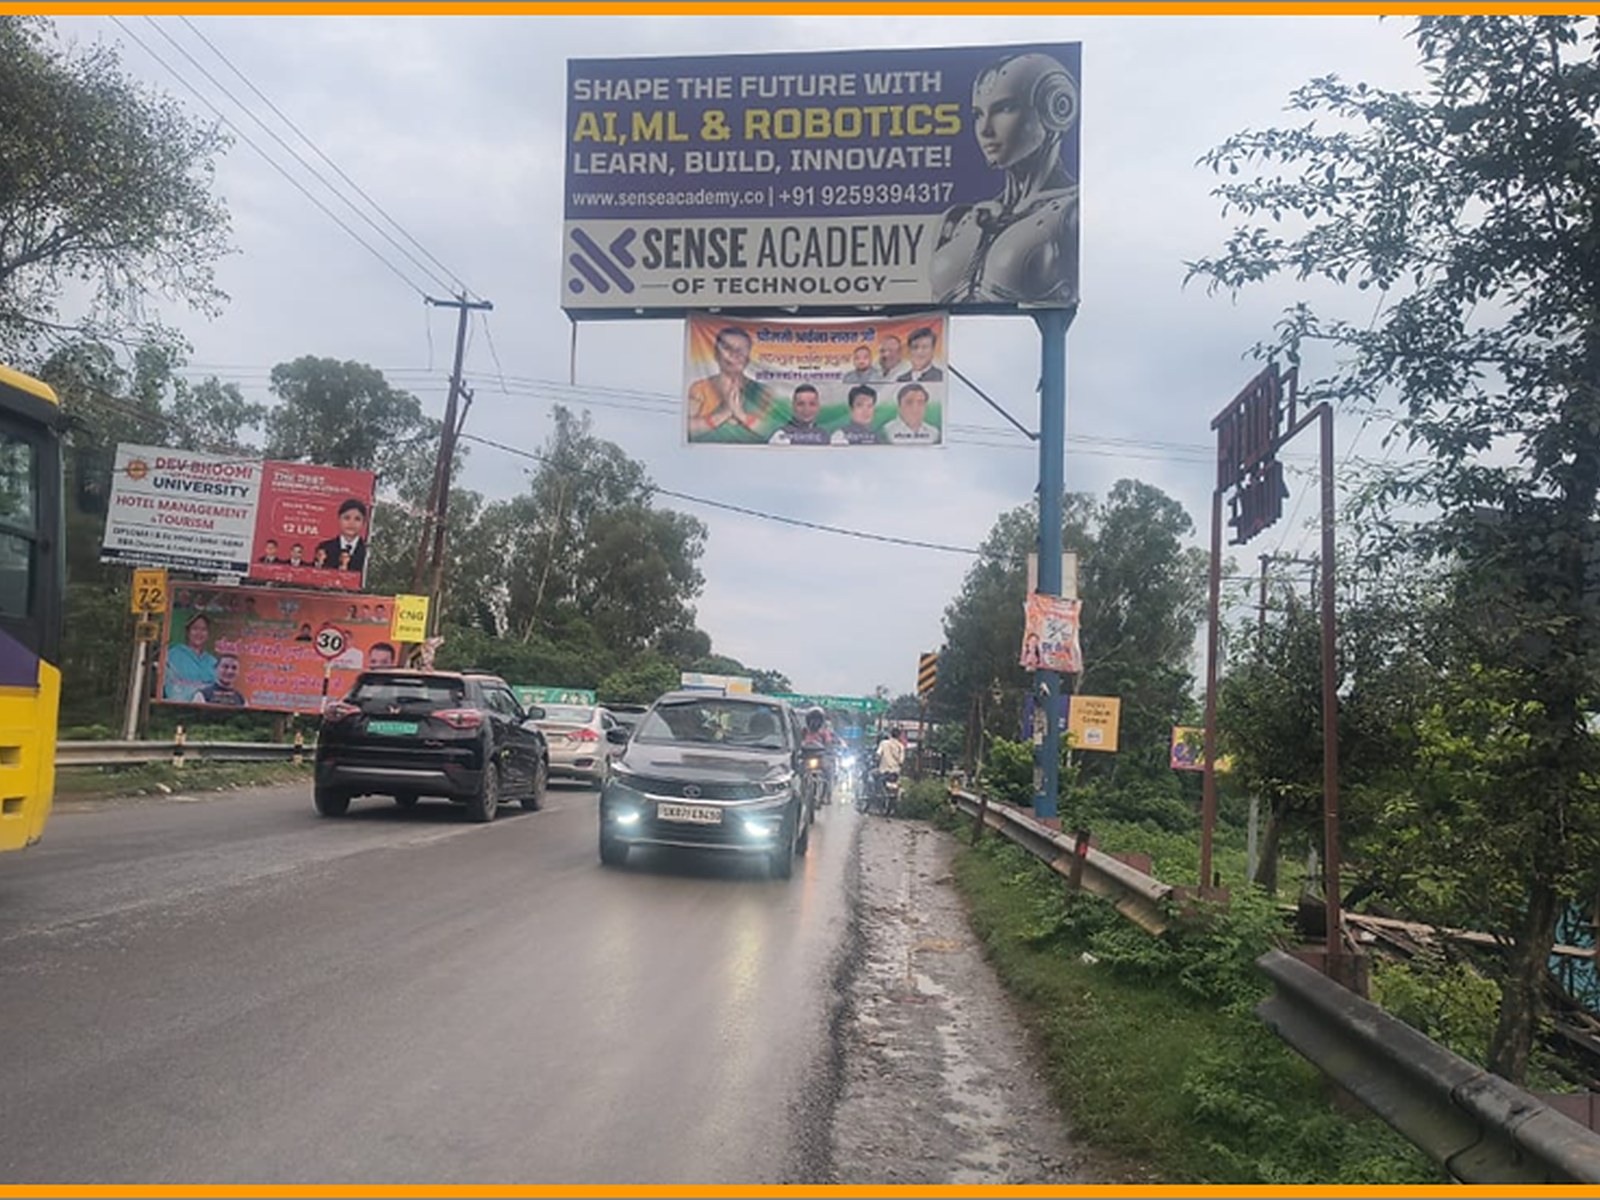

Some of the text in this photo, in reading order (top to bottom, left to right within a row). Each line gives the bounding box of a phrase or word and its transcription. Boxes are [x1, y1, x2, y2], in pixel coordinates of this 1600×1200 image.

[574, 71, 942, 101] SHAPE THE FUTURE WITH
[573, 103, 962, 146] AI,ML & ROBOTICS
[573, 146, 952, 176] LEARN, BUILD, INNOVATE!
[572, 187, 764, 208] www.senseacademy.co
[779, 186, 813, 206] +91
[821, 182, 954, 206] 9259394317
[642, 223, 925, 270] SENSE ACADEMY
[672, 276, 887, 295] OF TECHNOLOGY
[155, 457, 187, 472] DEV
[153, 477, 250, 498] UNIVERSITY
[116, 495, 249, 519] HOTEL MANAGEMENT
[158, 513, 215, 530] TOURISM
[139, 587, 162, 604] 72
[317, 633, 342, 651] 30
